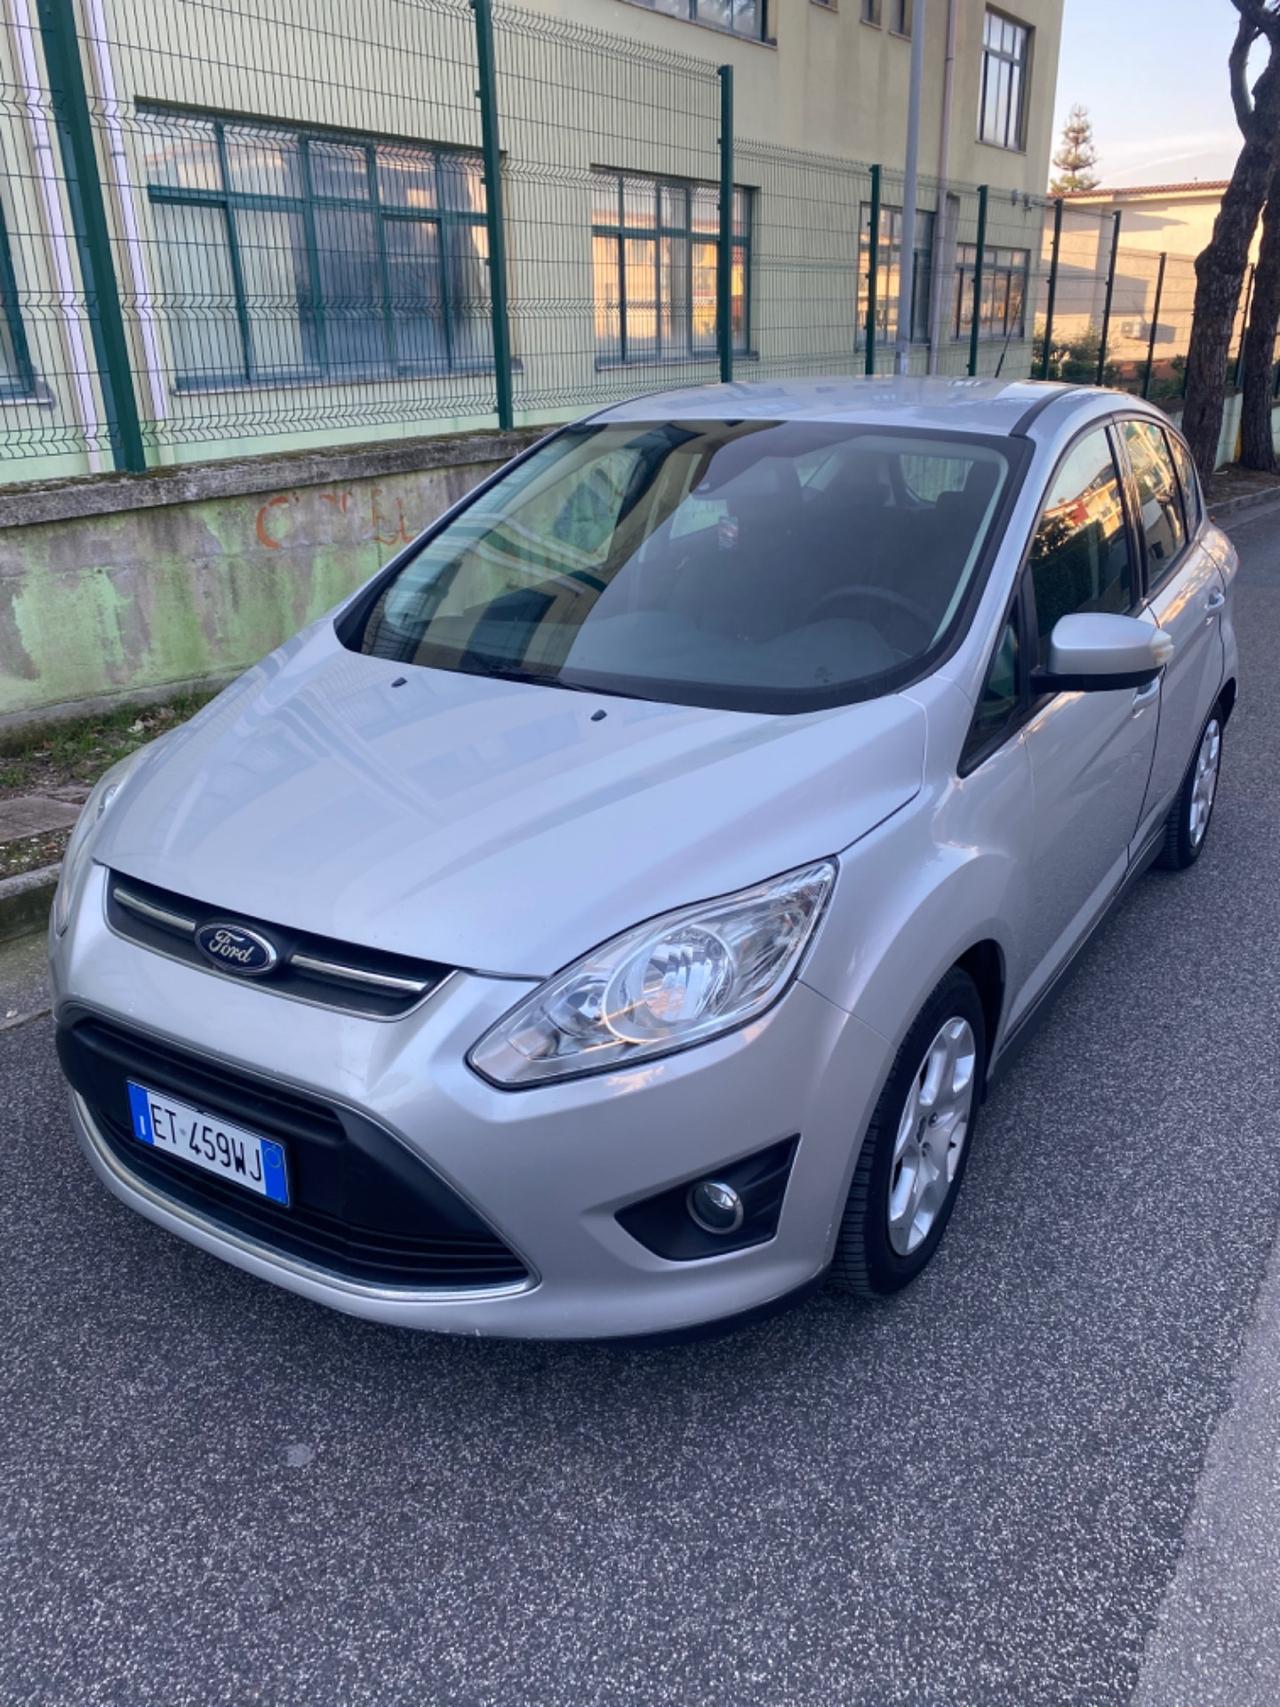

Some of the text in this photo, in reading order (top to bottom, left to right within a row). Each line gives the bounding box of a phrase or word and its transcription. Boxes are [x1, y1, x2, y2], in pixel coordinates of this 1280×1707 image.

[209, 930, 255, 963] Ford
[151, 1104, 262, 1181] ET 459WJ
